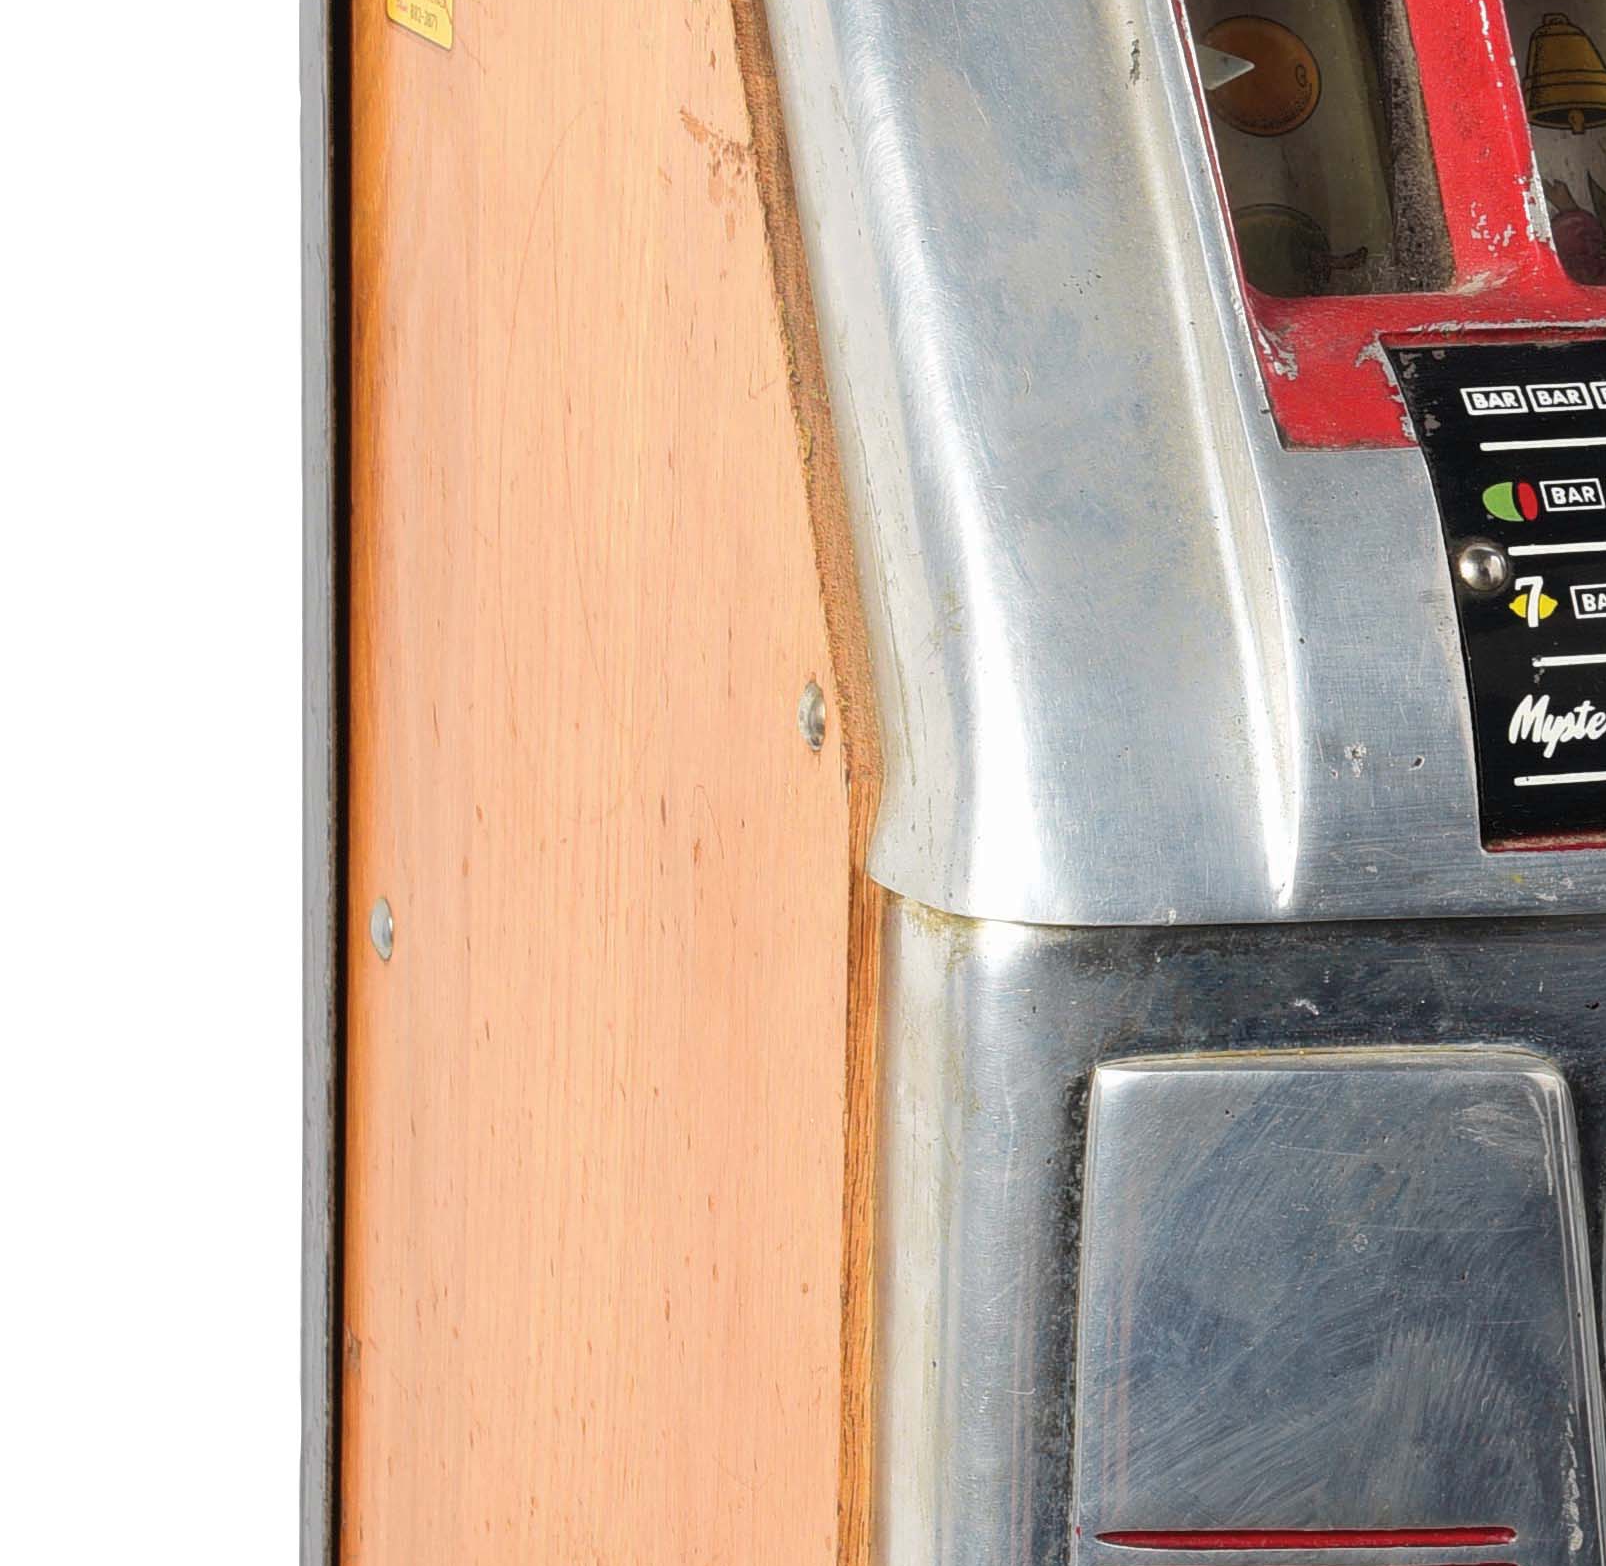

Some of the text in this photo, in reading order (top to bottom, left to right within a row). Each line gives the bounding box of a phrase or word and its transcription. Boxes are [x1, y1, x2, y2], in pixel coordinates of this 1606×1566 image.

[1471, 391, 1520, 410] BAR
[1536, 388, 1585, 406] BAR
[1550, 484, 1598, 505] BAR
[1514, 576, 1546, 628] 7
